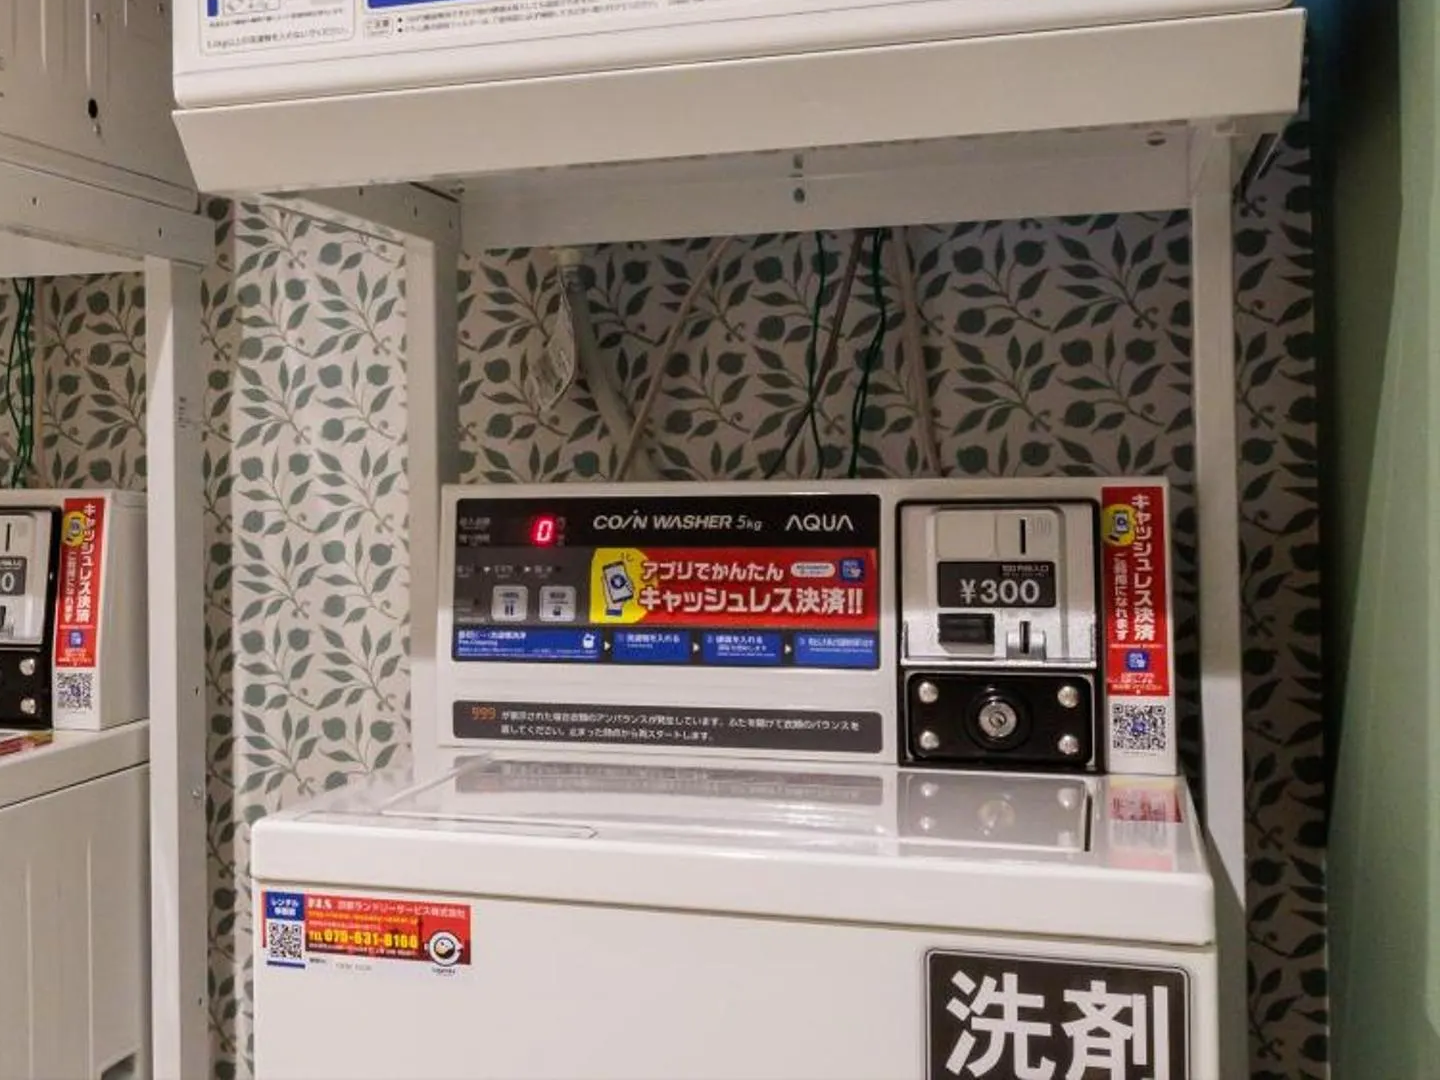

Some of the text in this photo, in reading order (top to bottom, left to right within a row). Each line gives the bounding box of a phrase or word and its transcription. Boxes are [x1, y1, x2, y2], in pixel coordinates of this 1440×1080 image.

[536, 520, 553, 541] 0
[653, 515, 733, 530] WASHER
[785, 515, 853, 531] AQUA
[76, 503, 96, 624] キャッシュレス決済
[642, 561, 784, 581] アプリでかんたん
[1133, 494, 1157, 641] キャッシュレス決済
[638, 588, 863, 615] キャッシュレス決済!!
[960, 579, 1040, 604] ¥300
[946, 970, 1170, 1080] 洗剤
